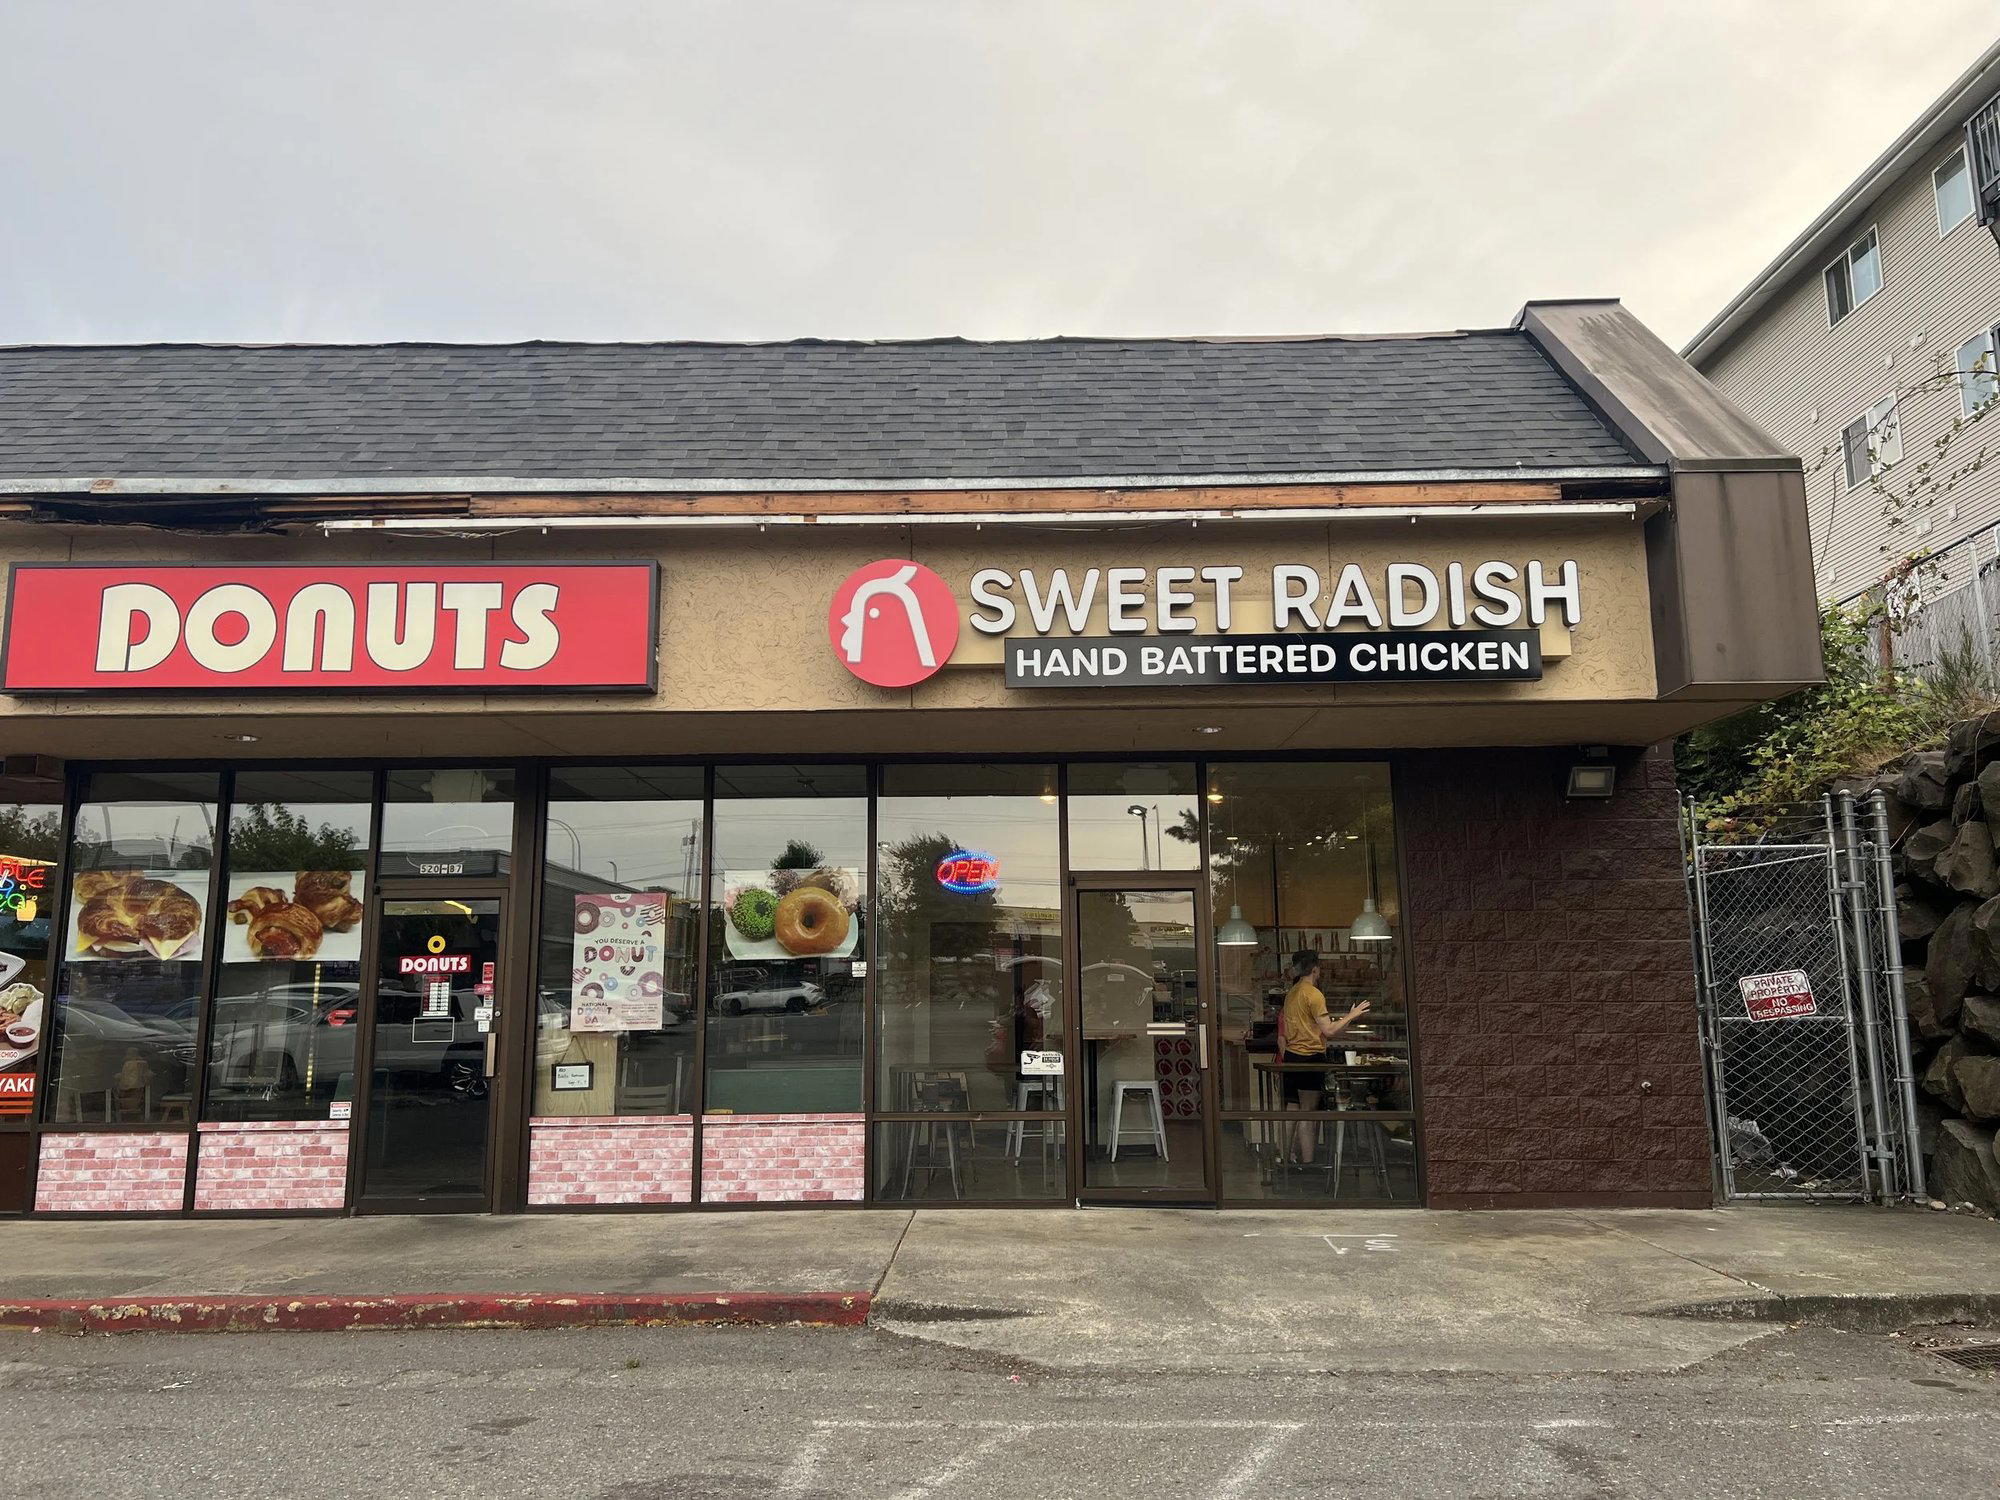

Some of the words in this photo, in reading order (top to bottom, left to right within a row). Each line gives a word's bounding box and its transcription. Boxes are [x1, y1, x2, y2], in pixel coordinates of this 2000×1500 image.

[969, 566, 1243, 634] SWEET
[1273, 560, 1581, 631] RADISH
[95, 582, 561, 673] DONUTS
[1015, 647, 1128, 677] HAND
[1140, 643, 1337, 675] BATTERED
[1348, 640, 1530, 672] CHICKEN
[937, 860, 1000, 883] OPEN
[594, 937, 609, 945] YOU
[610, 937, 639, 946] DESERVE
[583, 945, 658, 963] DONUT
[401, 956, 468, 973] DONUTS
[1754, 975, 1795, 987] PRIVATE
[1750, 984, 1802, 998] PROPERTY
[1751, 1003, 1814, 1019] TRESPASSING
[1771, 997, 1788, 1008] NO
